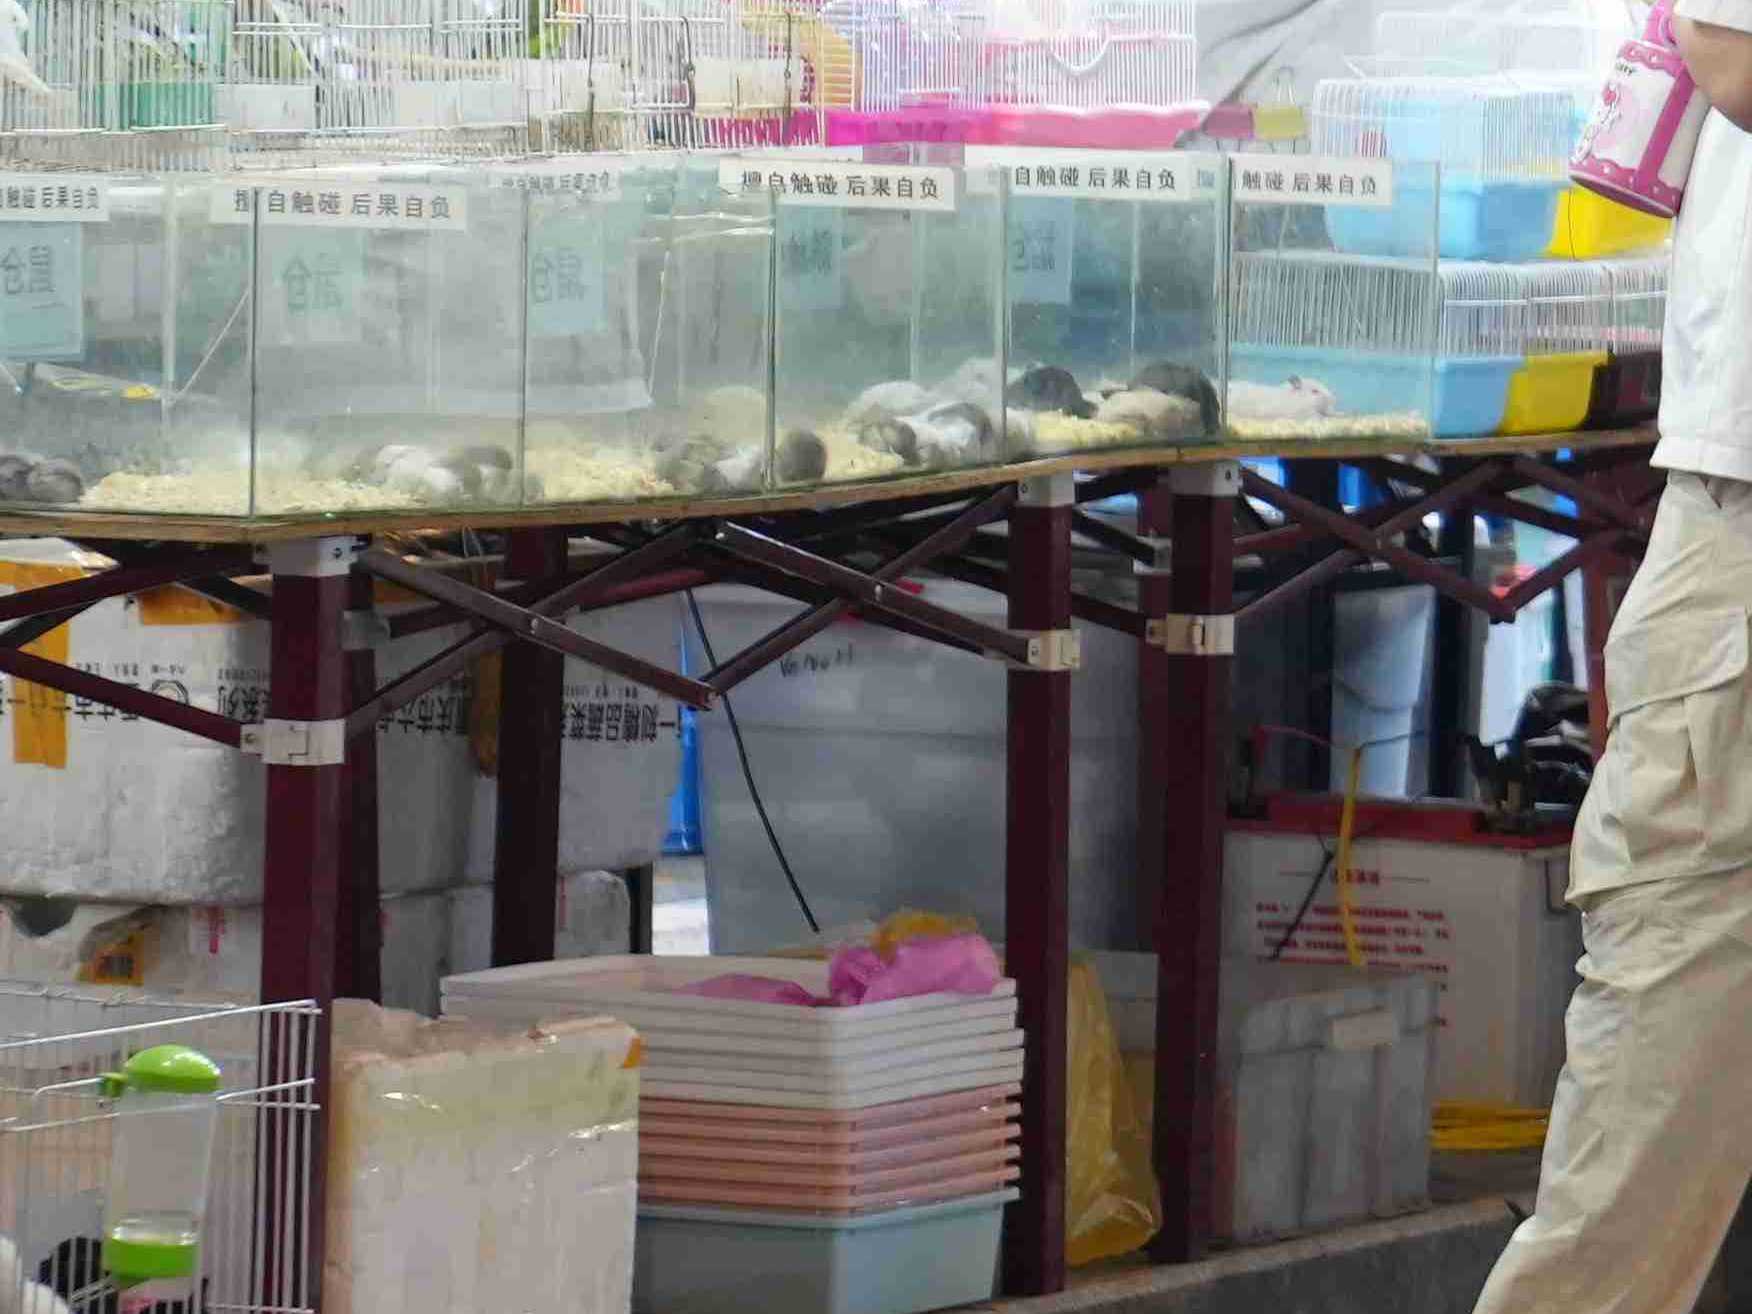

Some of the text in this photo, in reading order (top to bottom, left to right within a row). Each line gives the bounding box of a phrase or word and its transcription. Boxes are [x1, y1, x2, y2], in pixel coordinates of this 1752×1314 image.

[846, 175, 938, 200] 后果自负
[1087, 168, 1176, 190] 后果自负
[1291, 173, 1376, 196] 后果自负
[40, 185, 101, 210] 后果自负
[350, 192, 451, 220] 后果自负
